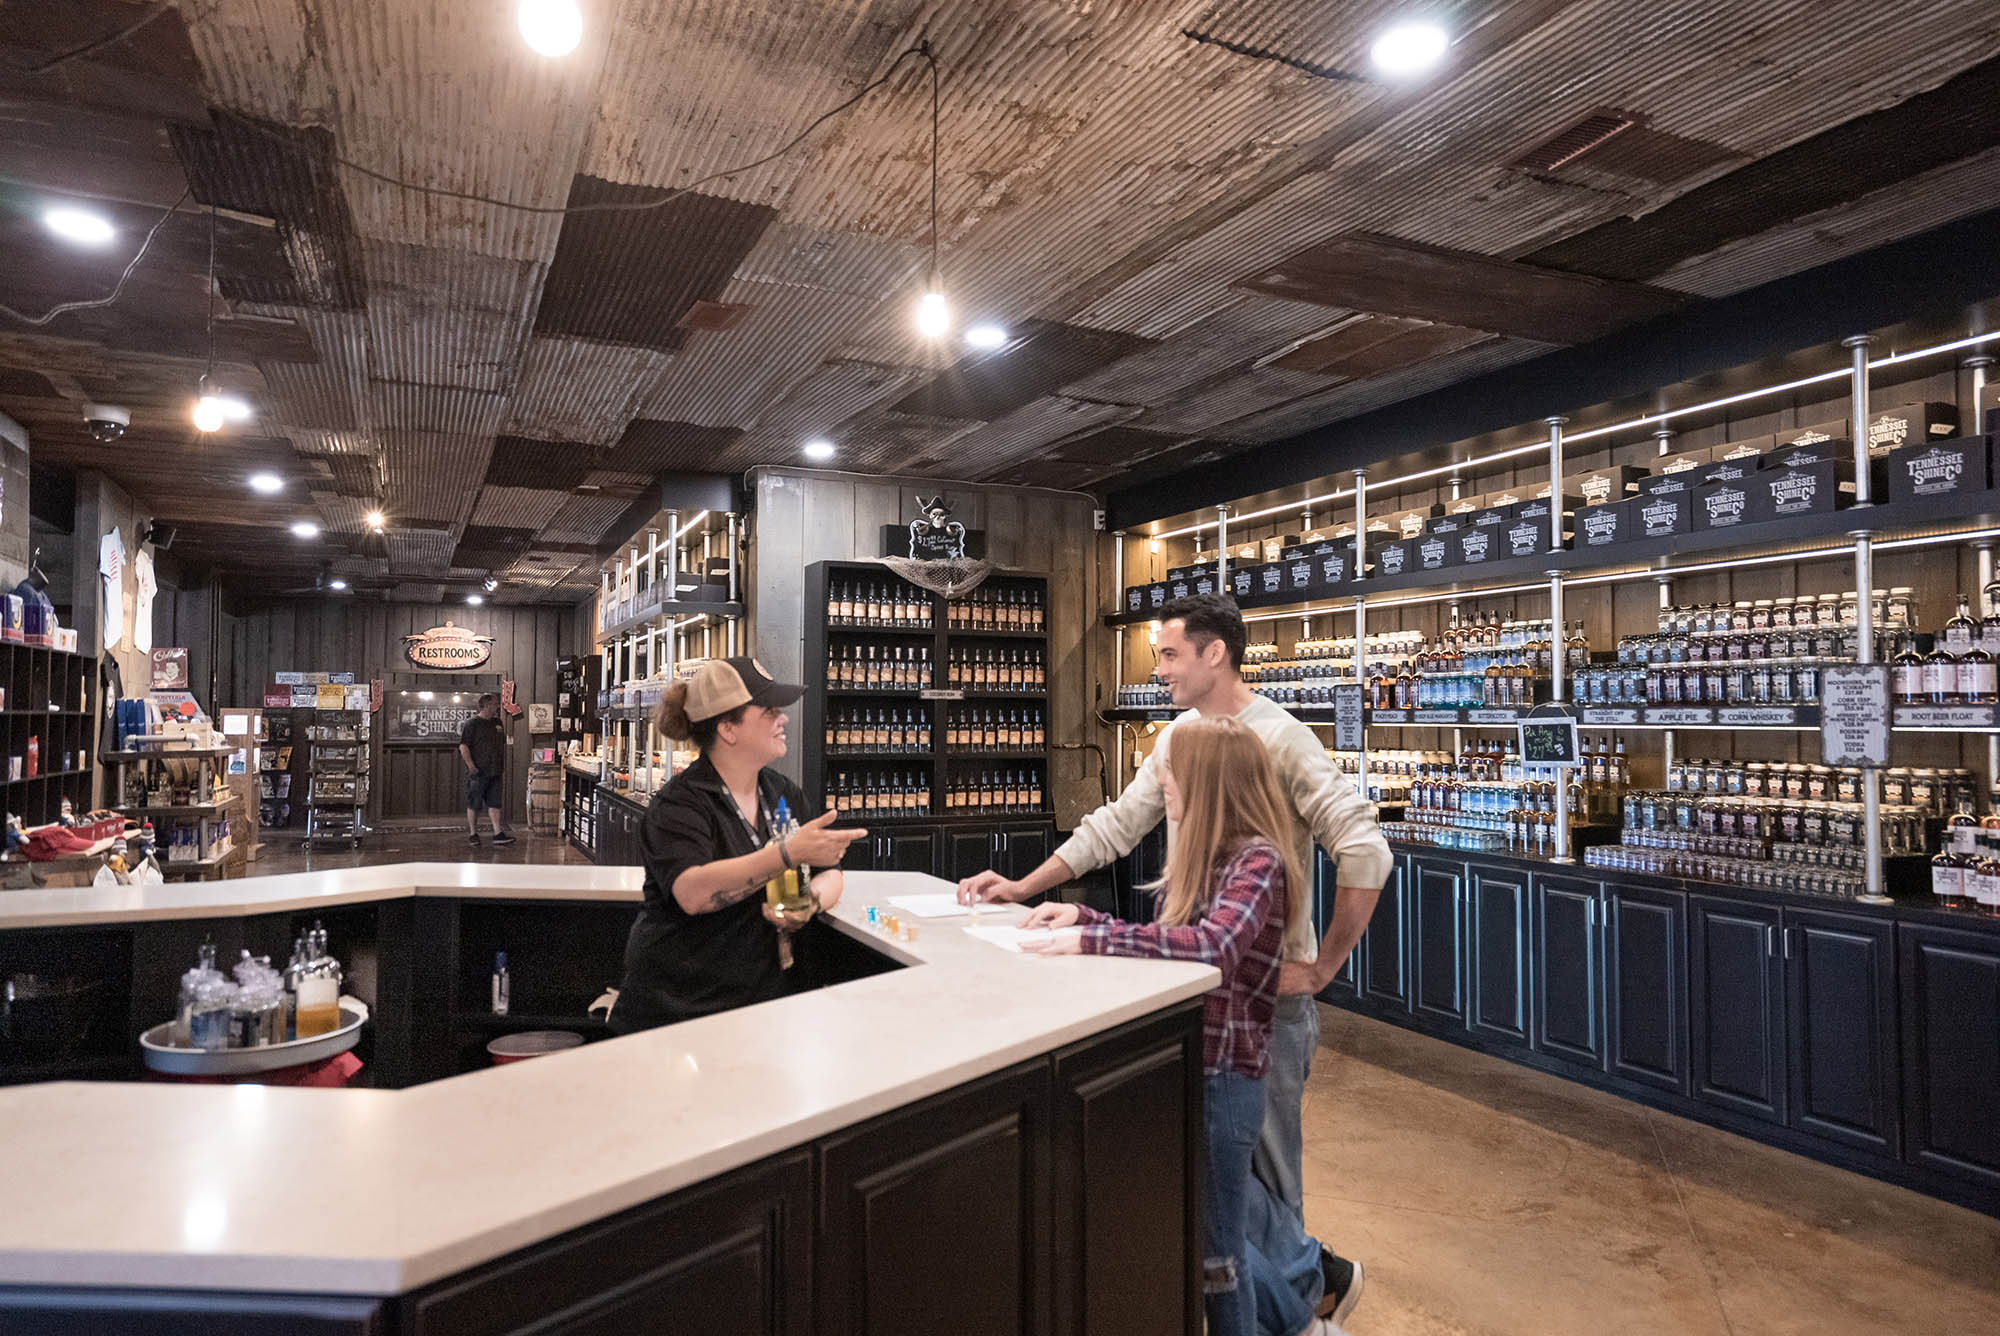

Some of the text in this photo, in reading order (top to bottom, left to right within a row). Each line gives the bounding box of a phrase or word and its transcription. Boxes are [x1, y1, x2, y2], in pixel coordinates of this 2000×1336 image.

[1869, 419, 1908, 434] ENNESSEE
[1906, 453, 1963, 476] TENNESSEE
[1914, 467, 1946, 485] SHINE
[1769, 475, 1817, 496] TENNESSEE
[1704, 491, 1746, 511] TENNESSEE
[1776, 489, 1802, 505] SHINE
[1641, 503, 1679, 521] TENNESSEE
[1710, 504, 1733, 519] SHINE
[1583, 513, 1617, 531] TENNESSEE
[418, 647, 480, 659] RESTROOMS
[1658, 713, 1698, 721] APPLE PIE
[1727, 713, 1785, 721] CORN WHISKEY
[417, 719, 456, 736] SHINE
